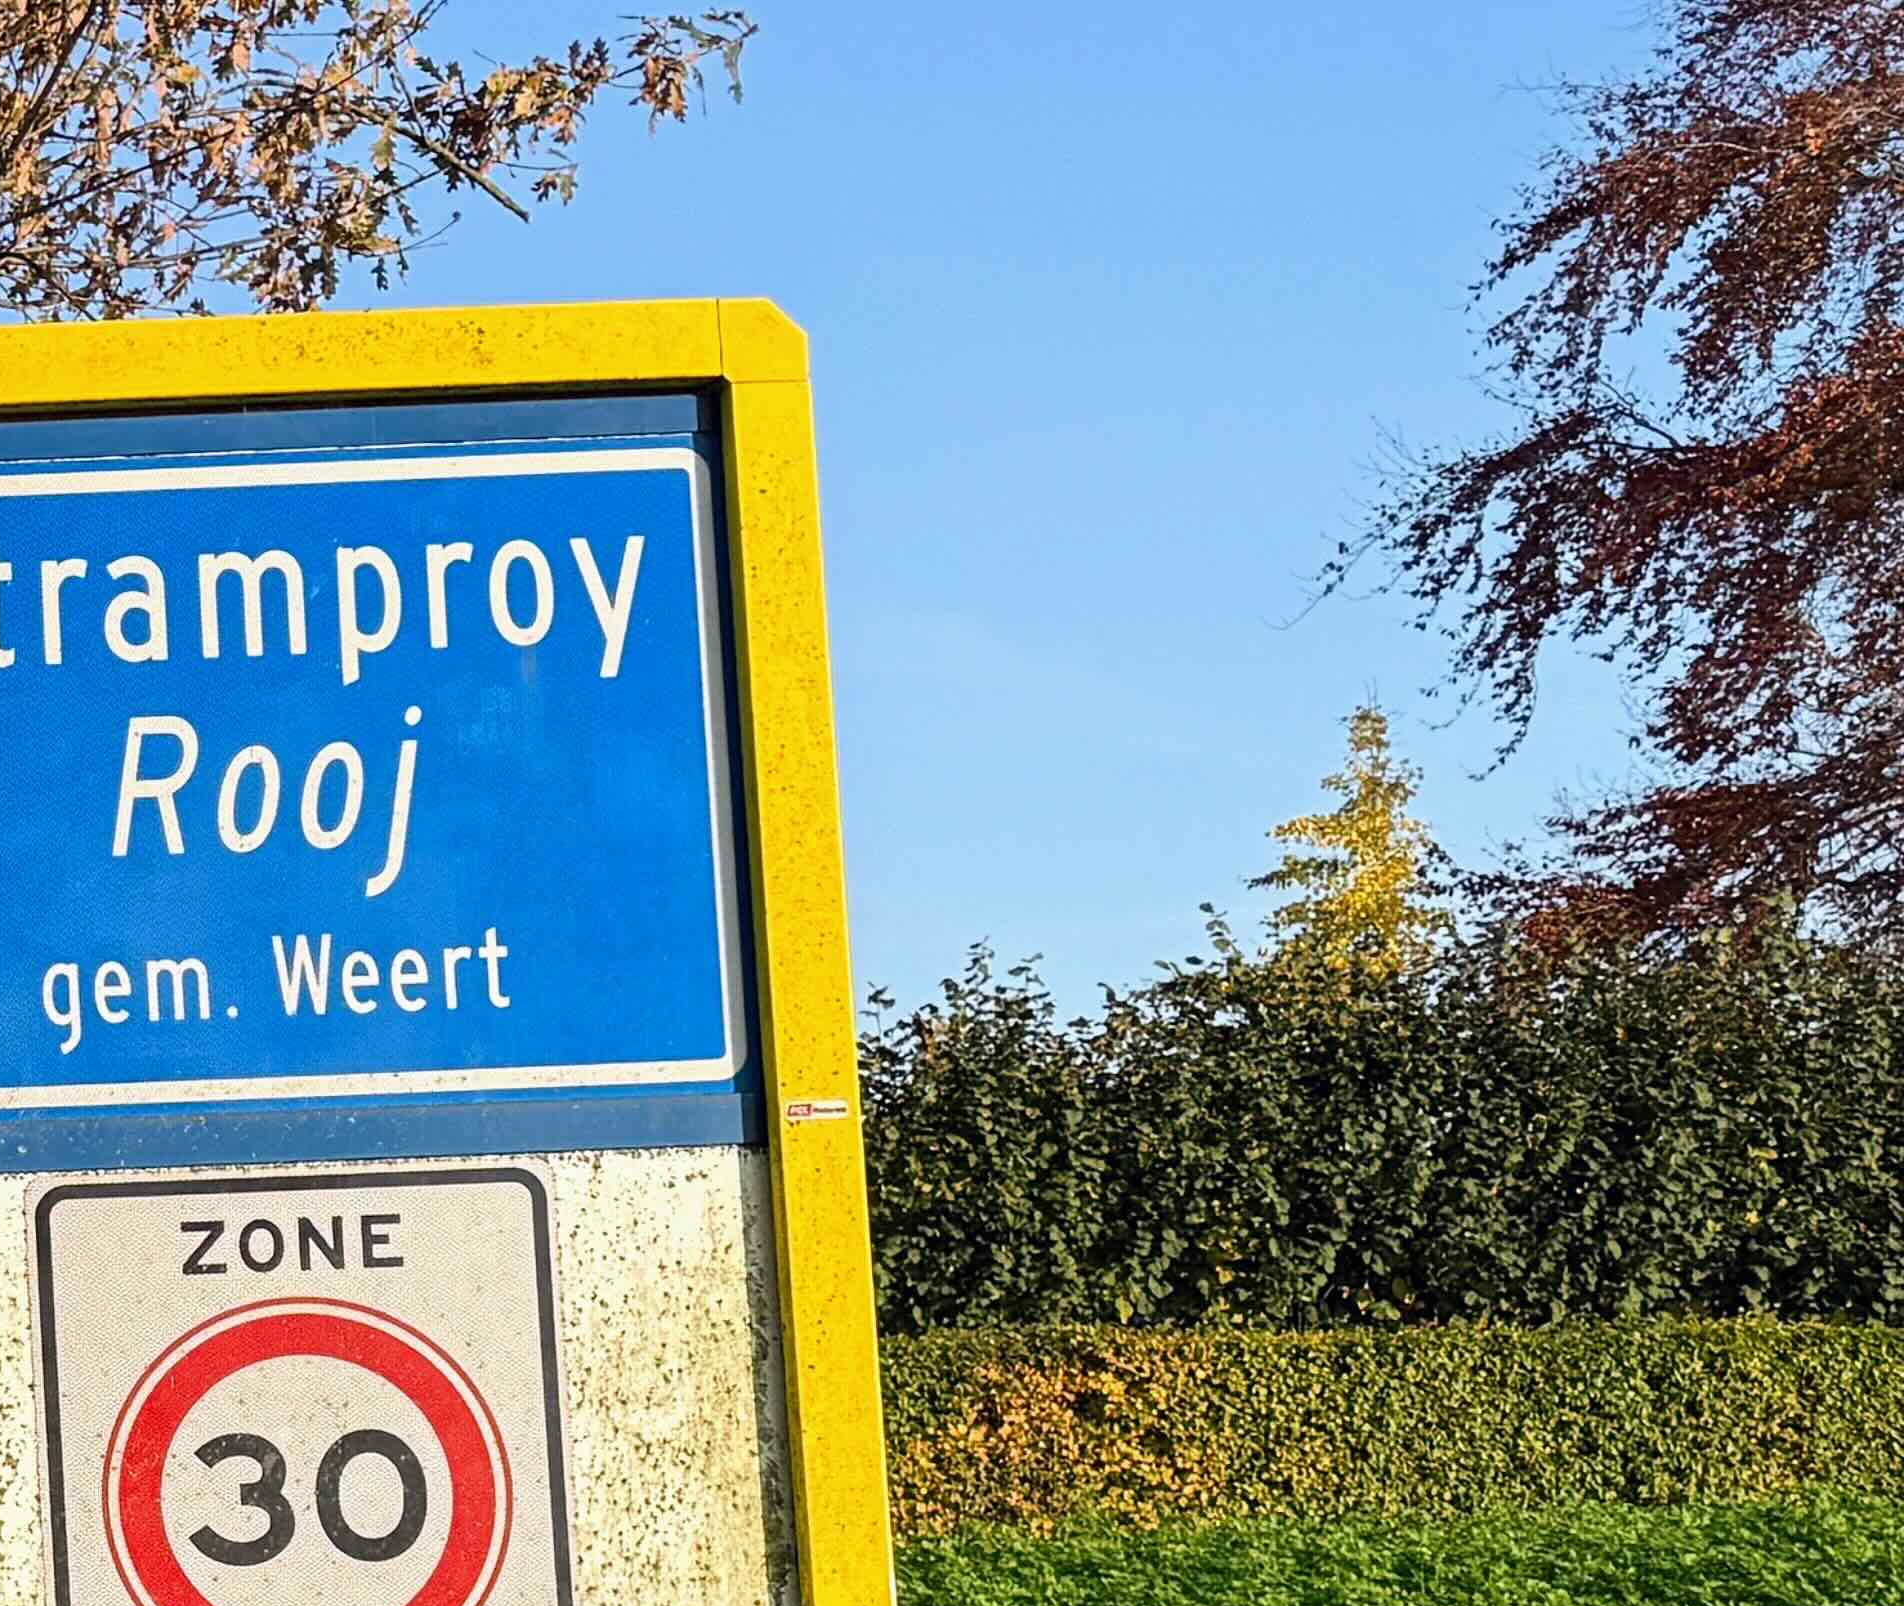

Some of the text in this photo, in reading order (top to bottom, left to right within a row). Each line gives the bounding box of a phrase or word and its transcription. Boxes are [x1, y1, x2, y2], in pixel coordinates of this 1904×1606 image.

[111, 704, 423, 898] Rooj
[41, 926, 511, 1056] gem. Weert
[179, 1212, 405, 1277] ZONE
[187, 1426, 429, 1568] 30
